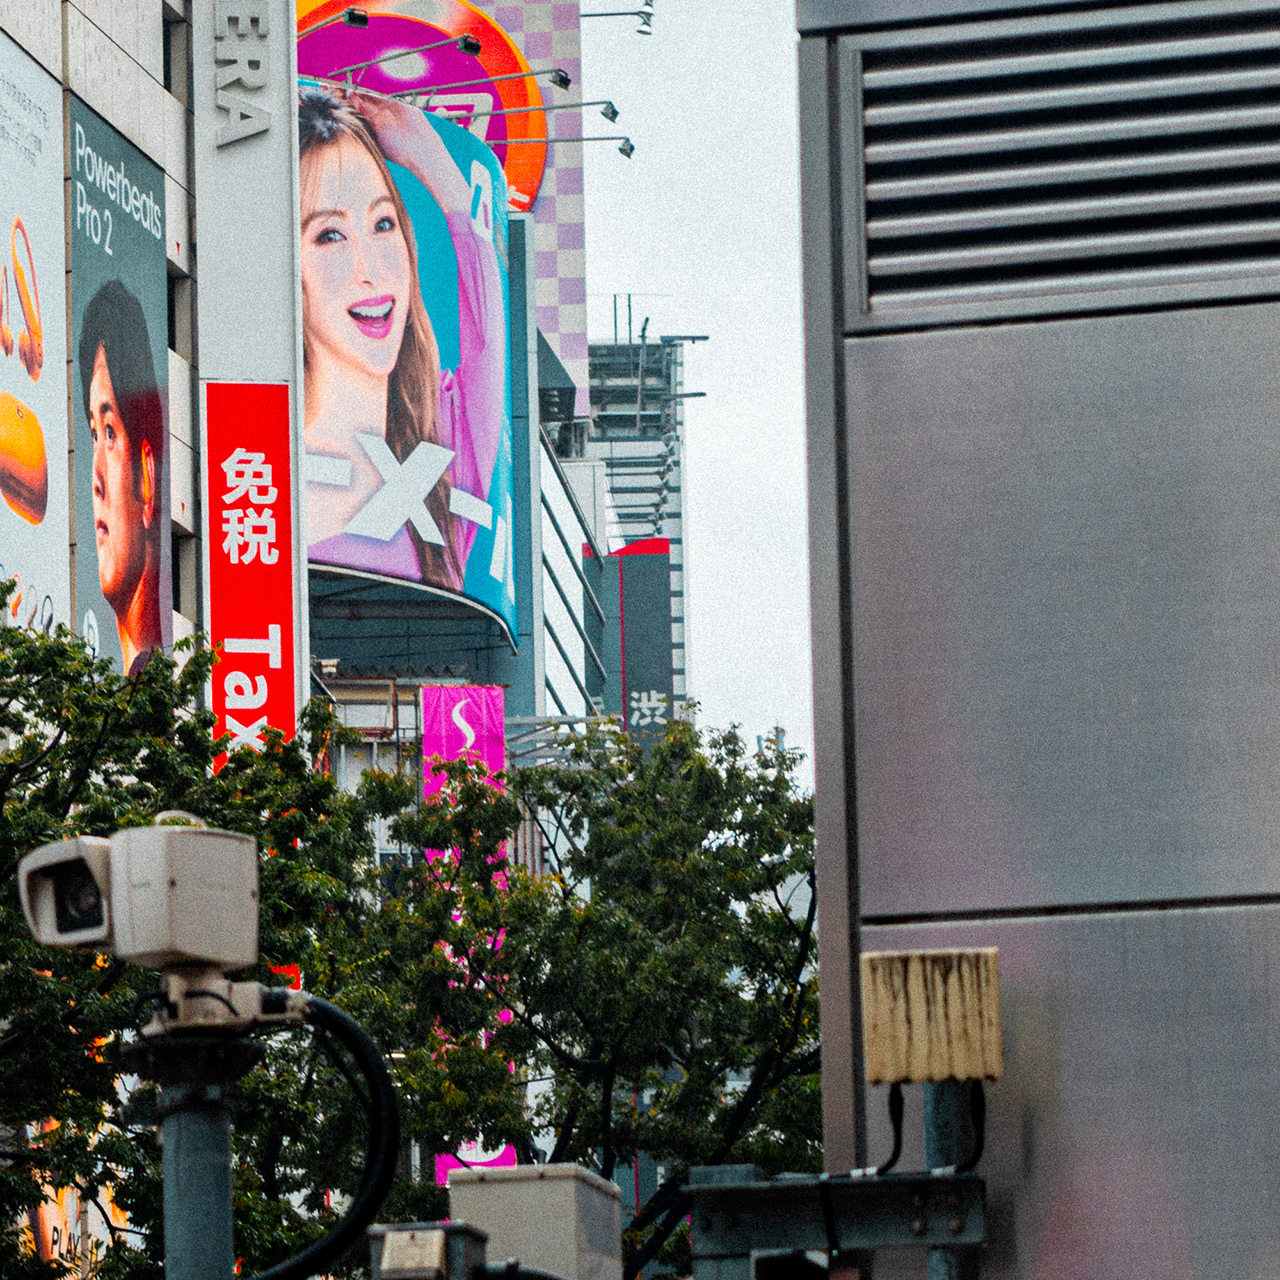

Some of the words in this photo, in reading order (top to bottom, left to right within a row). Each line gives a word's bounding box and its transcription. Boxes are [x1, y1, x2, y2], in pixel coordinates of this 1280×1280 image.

[75, 121, 162, 240] Powerbeats
[76, 180, 101, 245] Pro
[103, 208, 113, 256] 2
[221, 447, 280, 565] 免税
